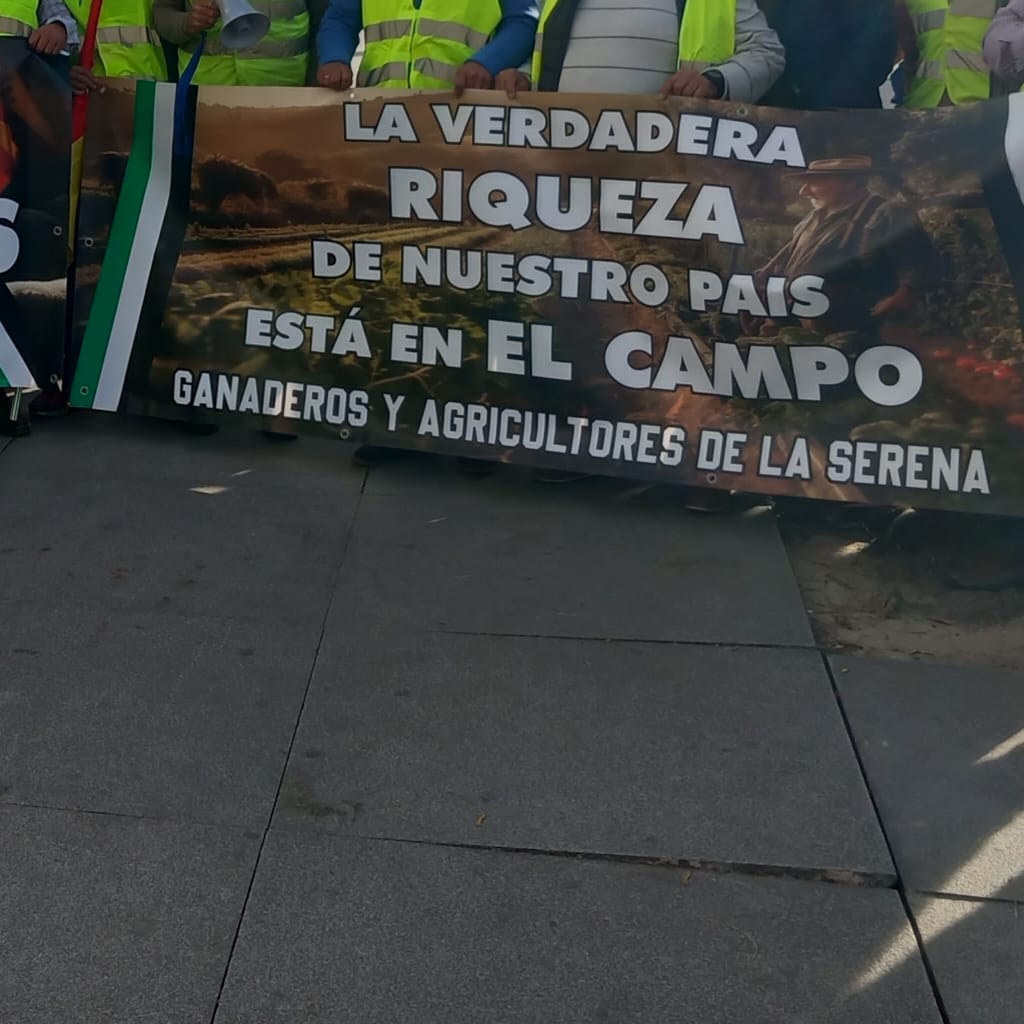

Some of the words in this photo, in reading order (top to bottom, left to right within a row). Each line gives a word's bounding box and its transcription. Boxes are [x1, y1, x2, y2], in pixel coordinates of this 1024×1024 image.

[342, 101, 420, 143] LA
[430, 103, 807, 169] VERDADERA
[388, 166, 746, 246] RIQUEZA
[311, 239, 383, 282] DE
[402, 245, 670, 308] NUESTRO
[688, 267, 830, 318] PAIS
[244, 305, 373, 359] ESTÁ
[389, 322, 463, 369] EN
[486, 319, 573, 382] EL
[603, 330, 924, 408] CAMPO
[172, 369, 370, 429] GANADEROS
[382, 392, 406, 433] Y
[416, 397, 687, 467] AGRICULTORES
[695, 429, 750, 474] DE
[758, 434, 812, 480] LA
[826, 440, 991, 495] SERENA
